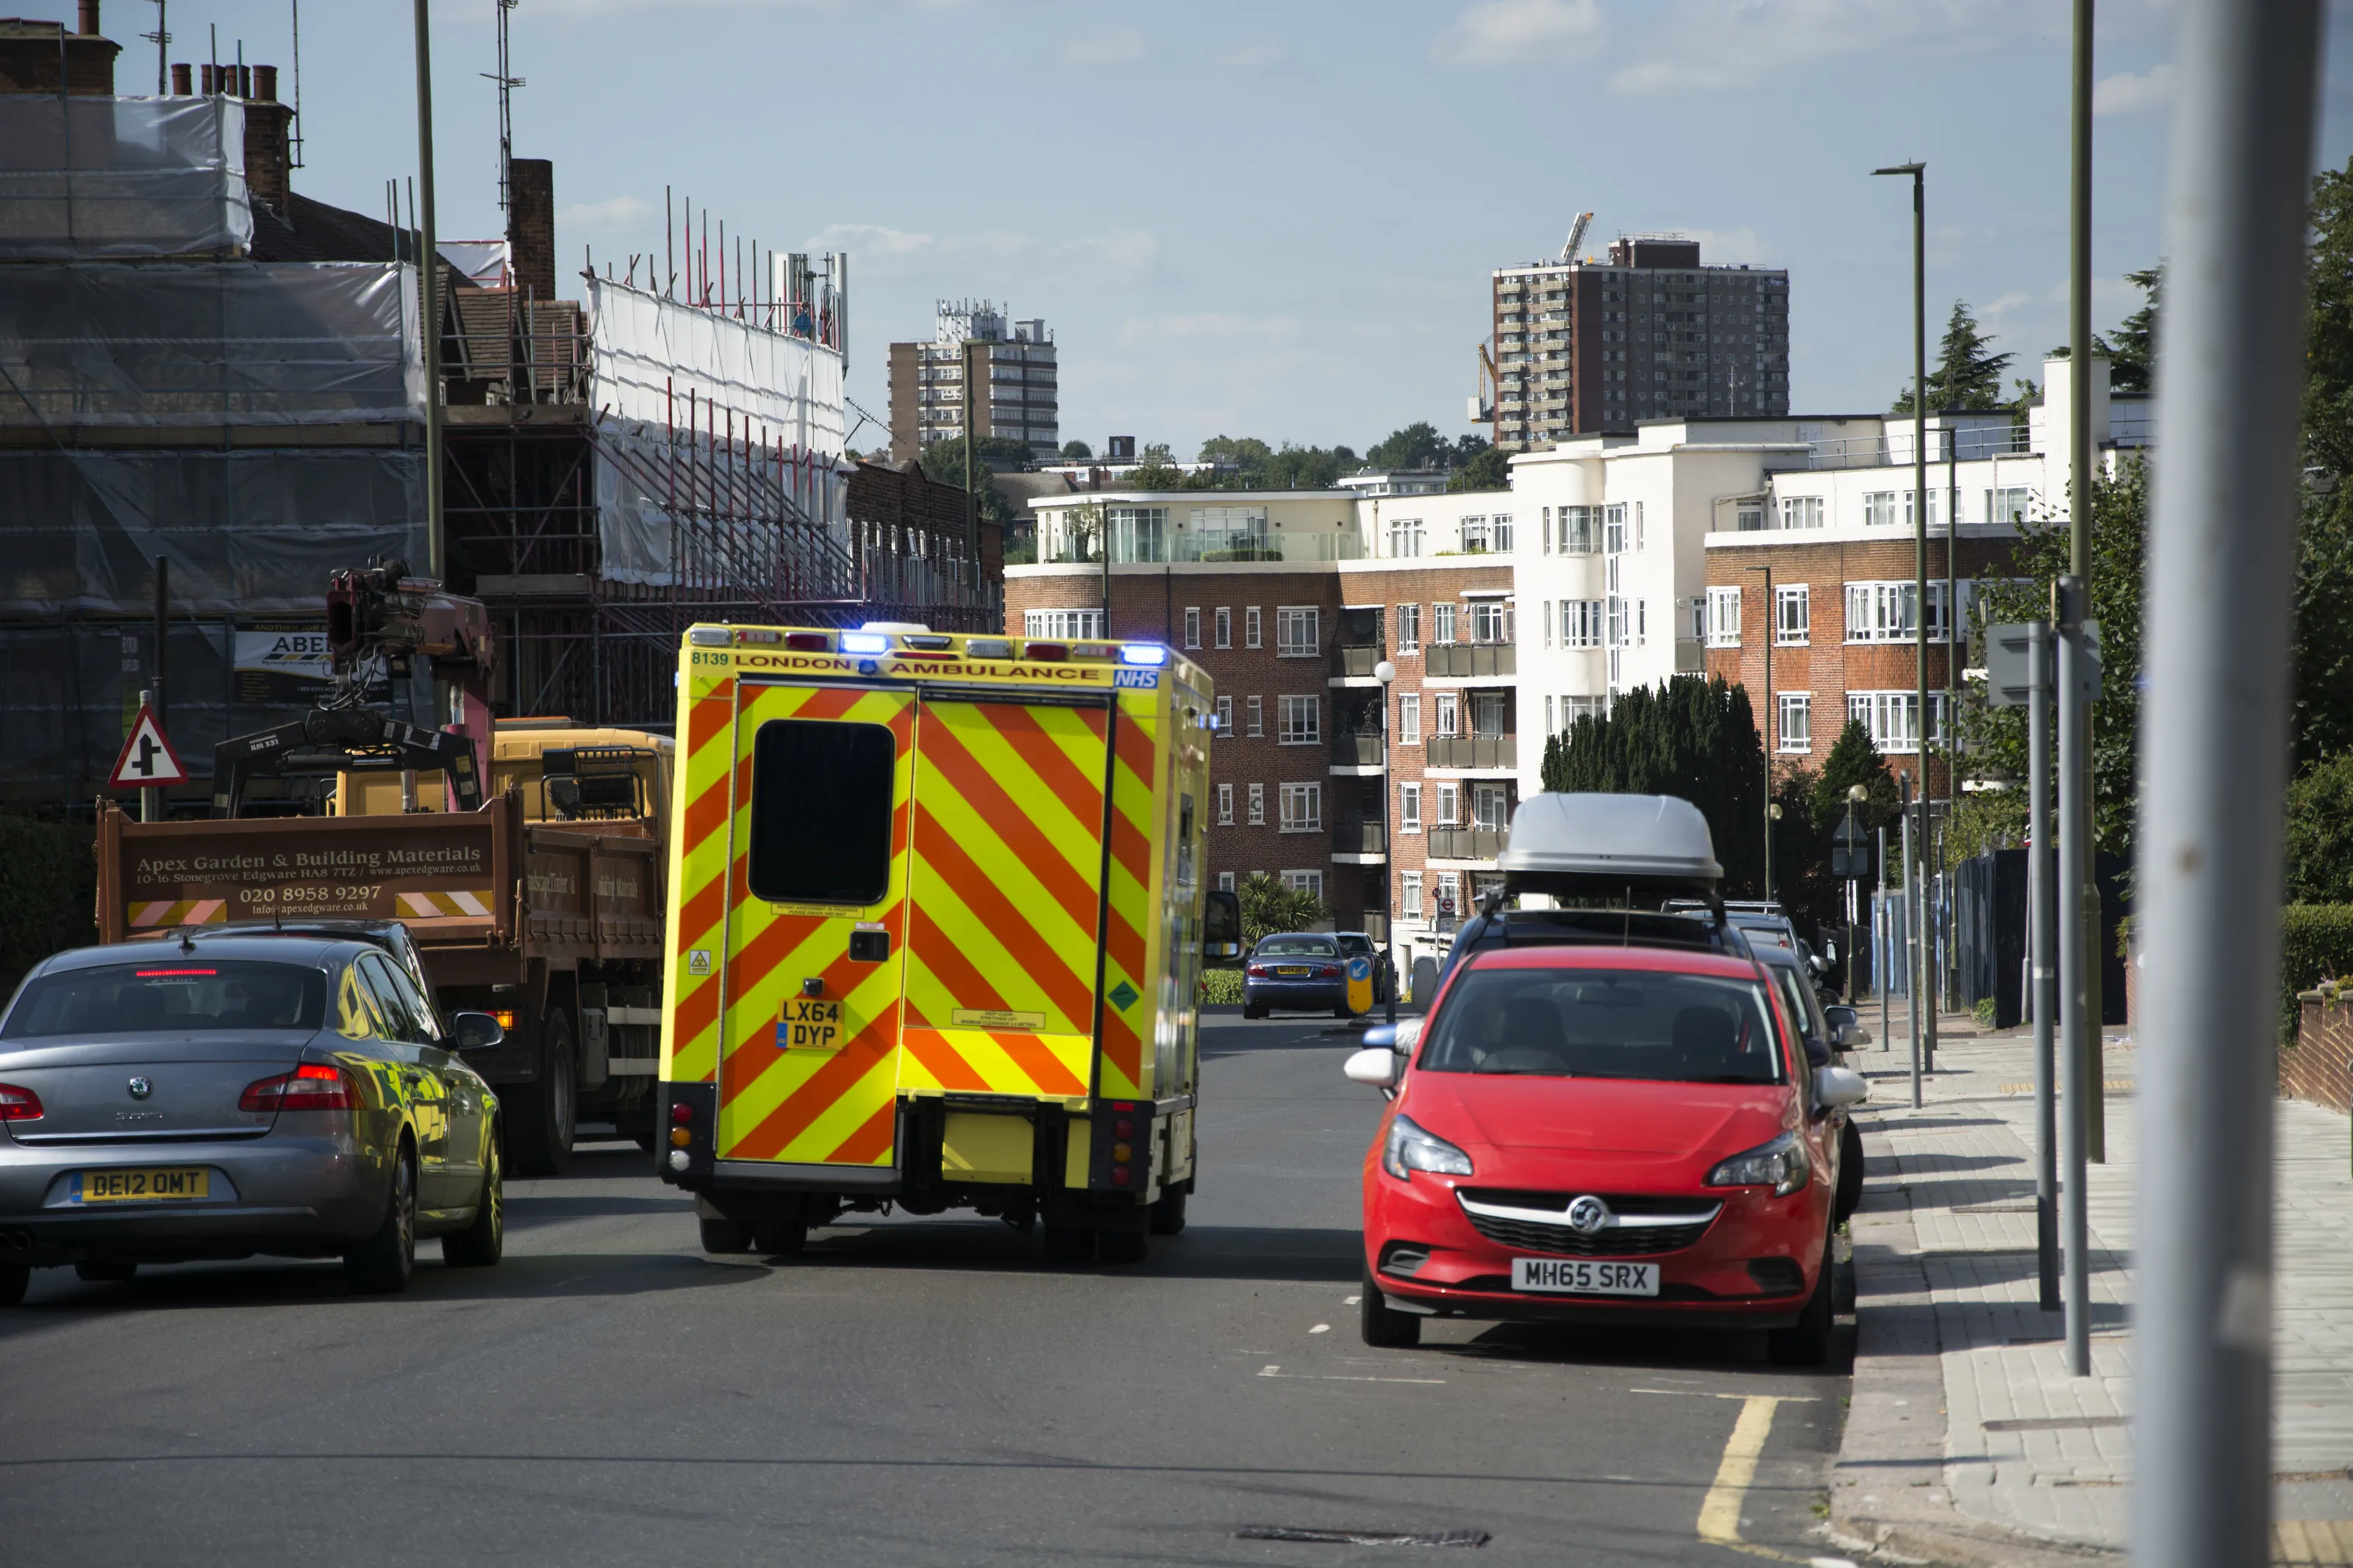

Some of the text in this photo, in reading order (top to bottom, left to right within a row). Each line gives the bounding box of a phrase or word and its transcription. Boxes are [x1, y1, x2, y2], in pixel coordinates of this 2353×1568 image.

[692, 652, 728, 666] 8139
[735, 655, 1100, 681] LONDON AMBULANCE
[1114, 670, 1157, 687] NHS
[250, 739, 279, 751] KM 331
[137, 847, 481, 874] Apex Garden & Building Materials
[137, 875, 169, 884] 10-16
[173, 872, 239, 884] Stonegrove
[243, 870, 296, 882] Edgware
[301, 868, 328, 878] HA8
[333, 867, 356, 877] 7TZ
[369, 863, 482, 876] www.apexedgware.co.uk
[240, 886, 382, 903] 020 8958 9297
[598, 876, 615, 903] uilding
[783, 1001, 838, 1023] LX64
[794, 1025, 835, 1045] DYP
[93, 1172, 201, 1197] DE12 OMT
[1525, 1262, 1648, 1289] MH65 SRX
